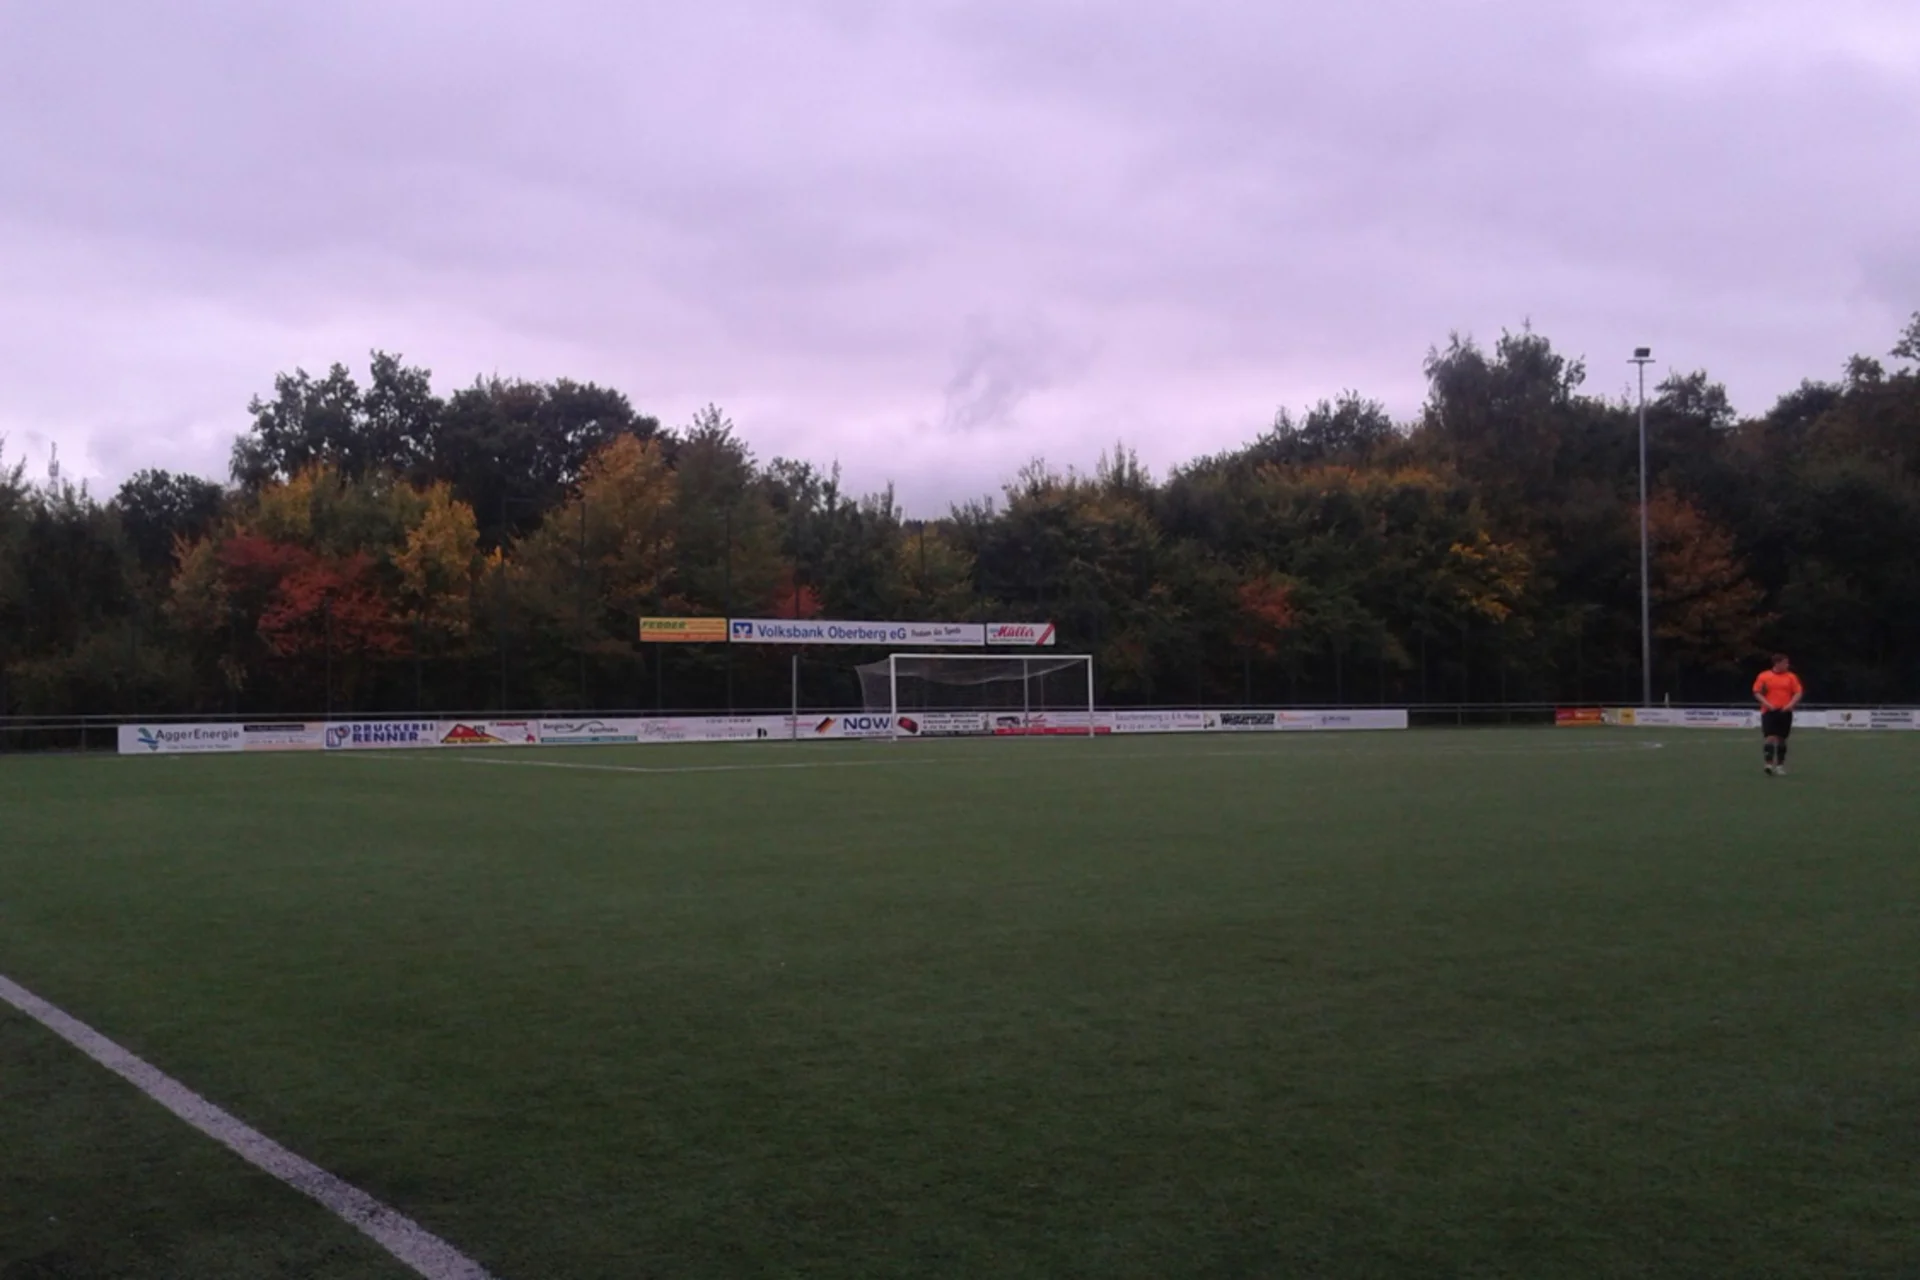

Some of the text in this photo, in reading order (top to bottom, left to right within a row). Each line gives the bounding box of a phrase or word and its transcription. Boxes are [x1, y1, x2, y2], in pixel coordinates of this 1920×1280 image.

[757, 624, 823, 639] Volksbank
[827, 626, 887, 641] Oberberg
[889, 628, 907, 640] eG
[352, 722, 435, 732] DRUCKEREI
[155, 728, 240, 742] AggerEnergie
[352, 731, 419, 742] RENNER
